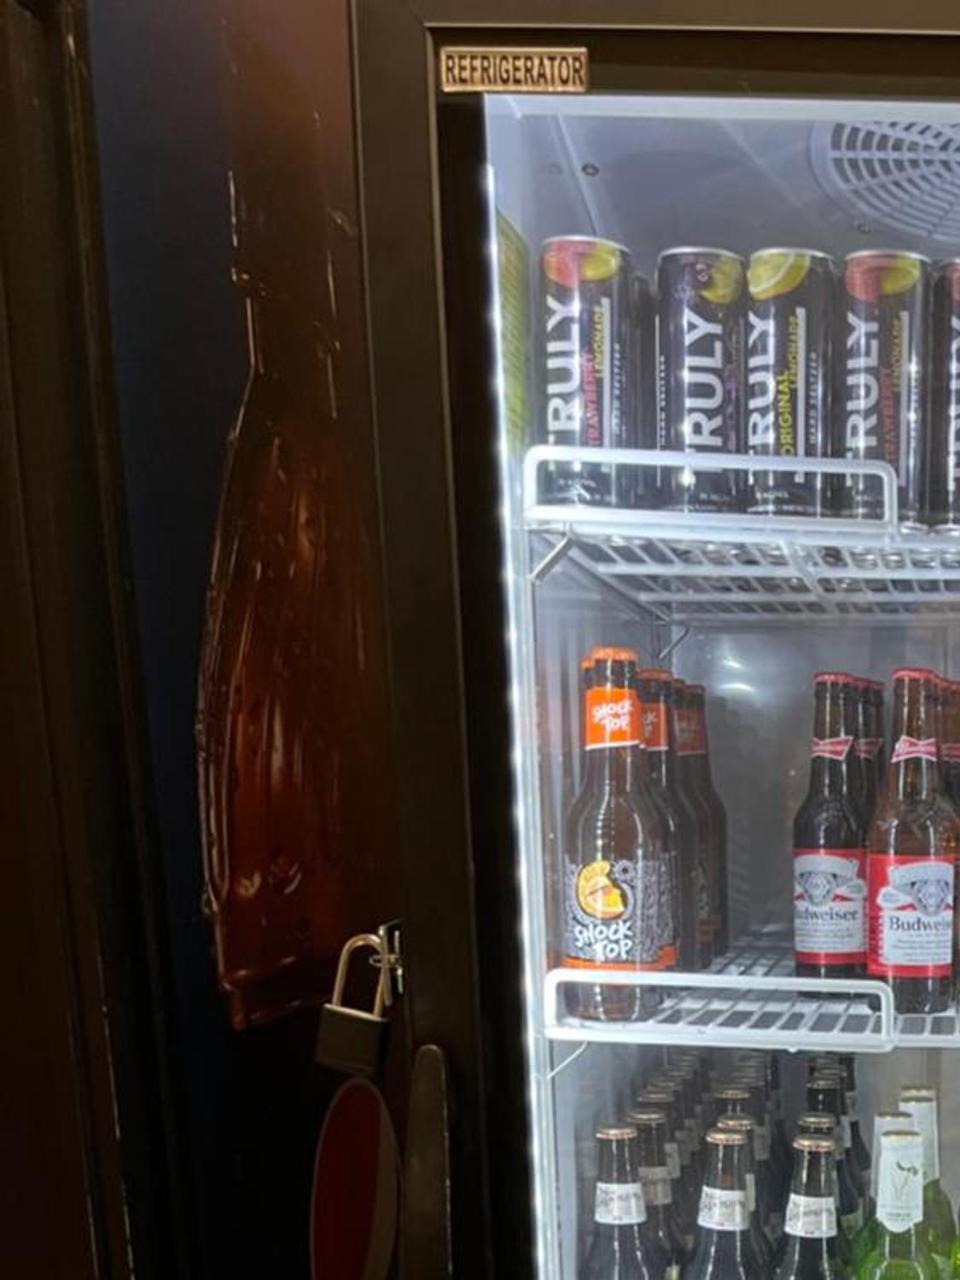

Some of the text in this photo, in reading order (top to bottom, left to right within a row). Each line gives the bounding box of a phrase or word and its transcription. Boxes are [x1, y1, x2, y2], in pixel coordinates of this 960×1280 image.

[445, 54, 585, 86] REFRIGERATOR
[776, 369, 795, 456] ORIGINAL
[575, 919, 632, 948] SHOCK
[593, 938, 632, 961] TOP
